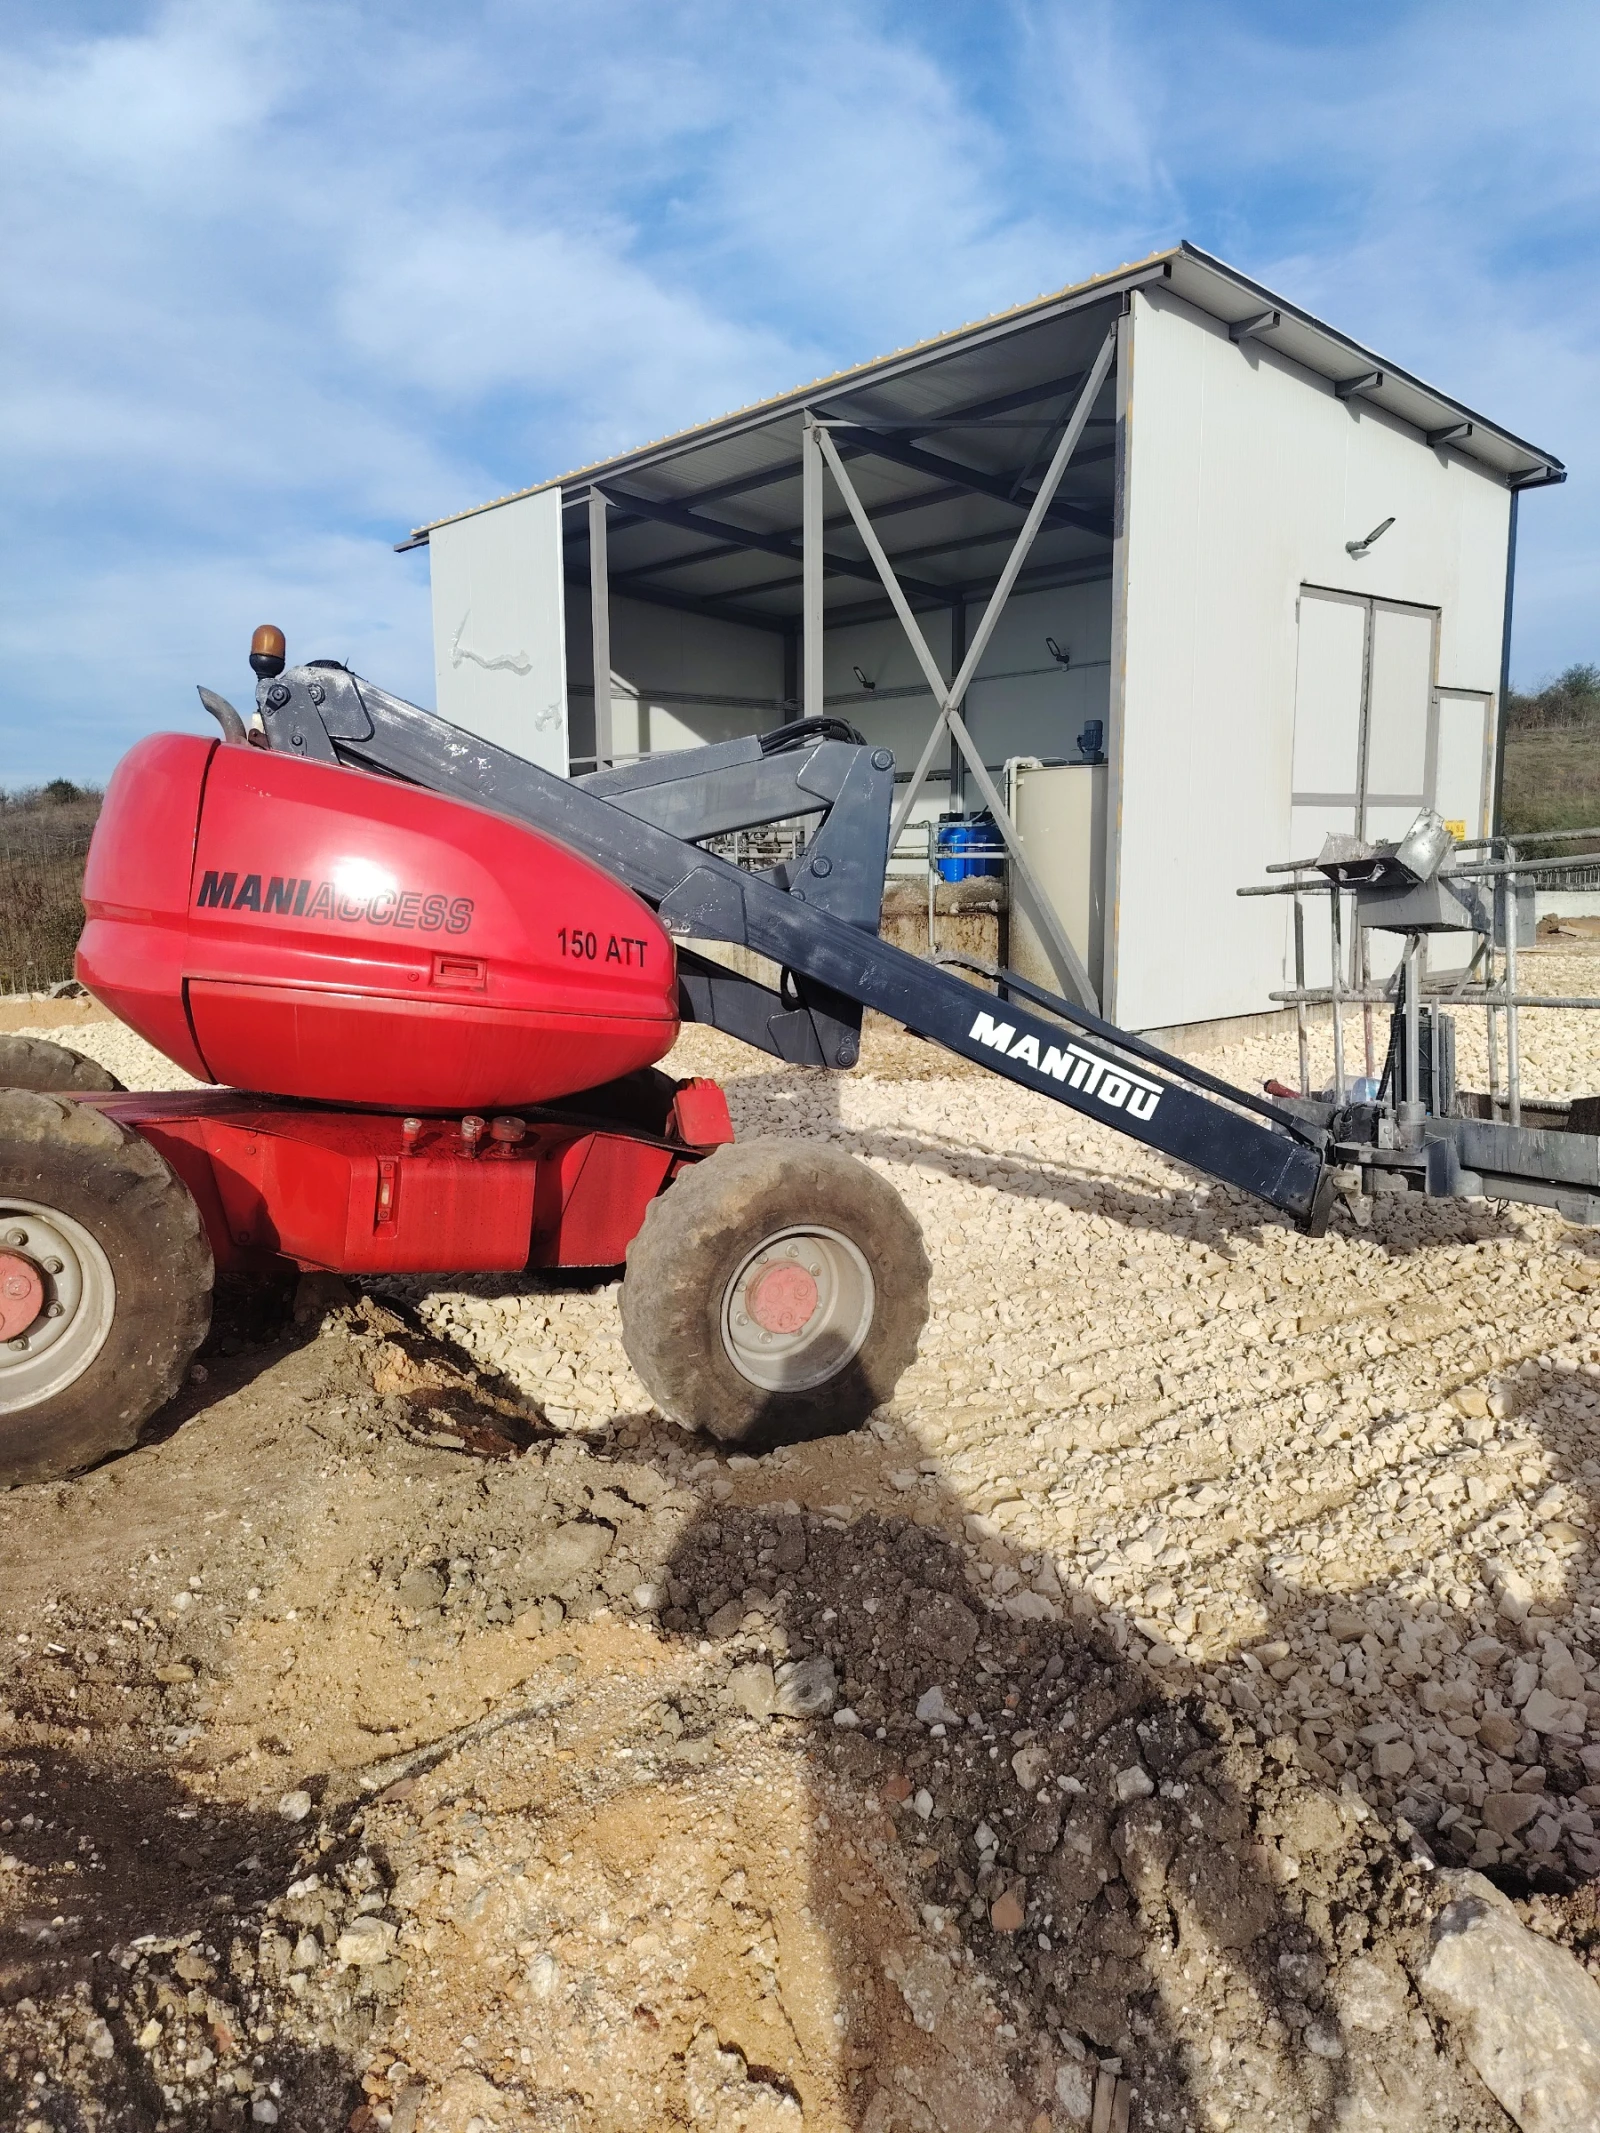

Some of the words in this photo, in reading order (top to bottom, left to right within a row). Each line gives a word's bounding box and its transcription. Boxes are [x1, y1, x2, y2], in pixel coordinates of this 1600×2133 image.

[196, 870, 475, 935] MANIACCESS
[557, 927, 597, 961] 150
[604, 935, 648, 968] ATT
[968, 1010, 1166, 1122] MANITOU
